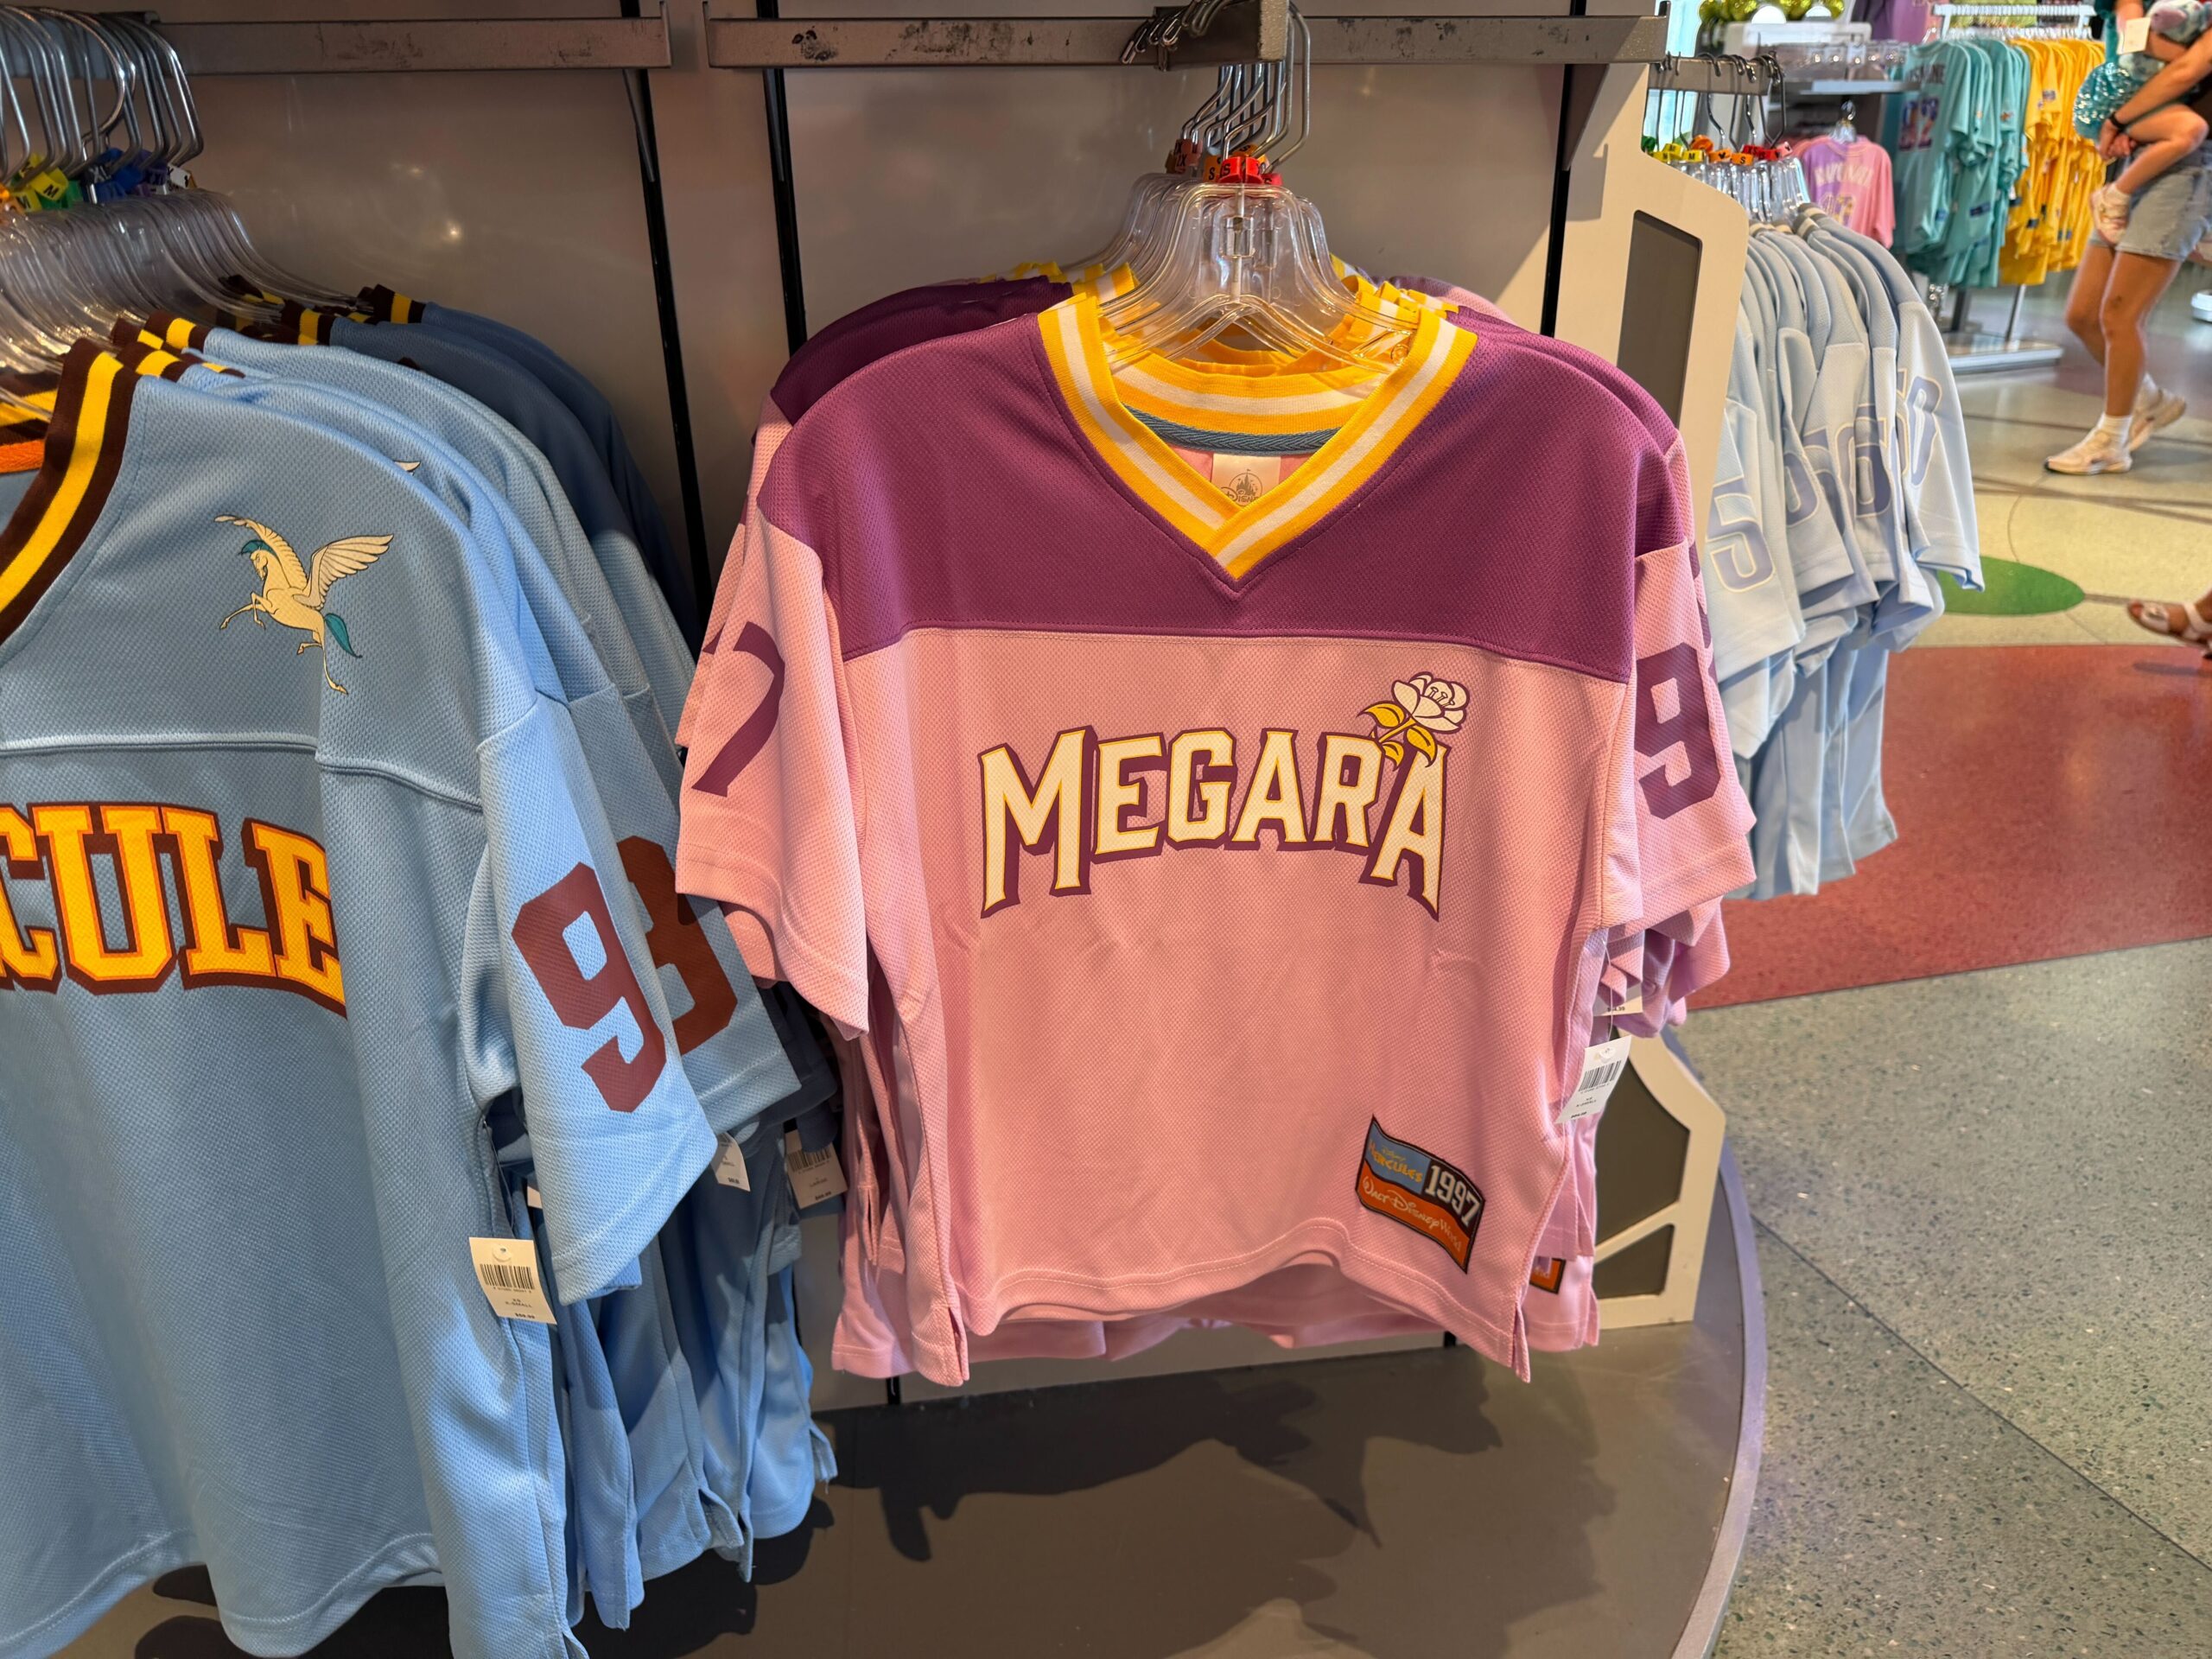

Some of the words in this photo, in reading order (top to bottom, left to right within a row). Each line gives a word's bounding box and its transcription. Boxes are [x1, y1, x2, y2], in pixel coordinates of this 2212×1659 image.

[43, 183, 60, 199] M
[1208, 167, 1216, 181] S
[1634, 642, 1720, 820] 9
[0, 801, 347, 1020] CULE
[977, 726, 1451, 922] MEGARA
[512, 861, 667, 1113] 9
[1425, 1165, 1480, 1227] 1997
